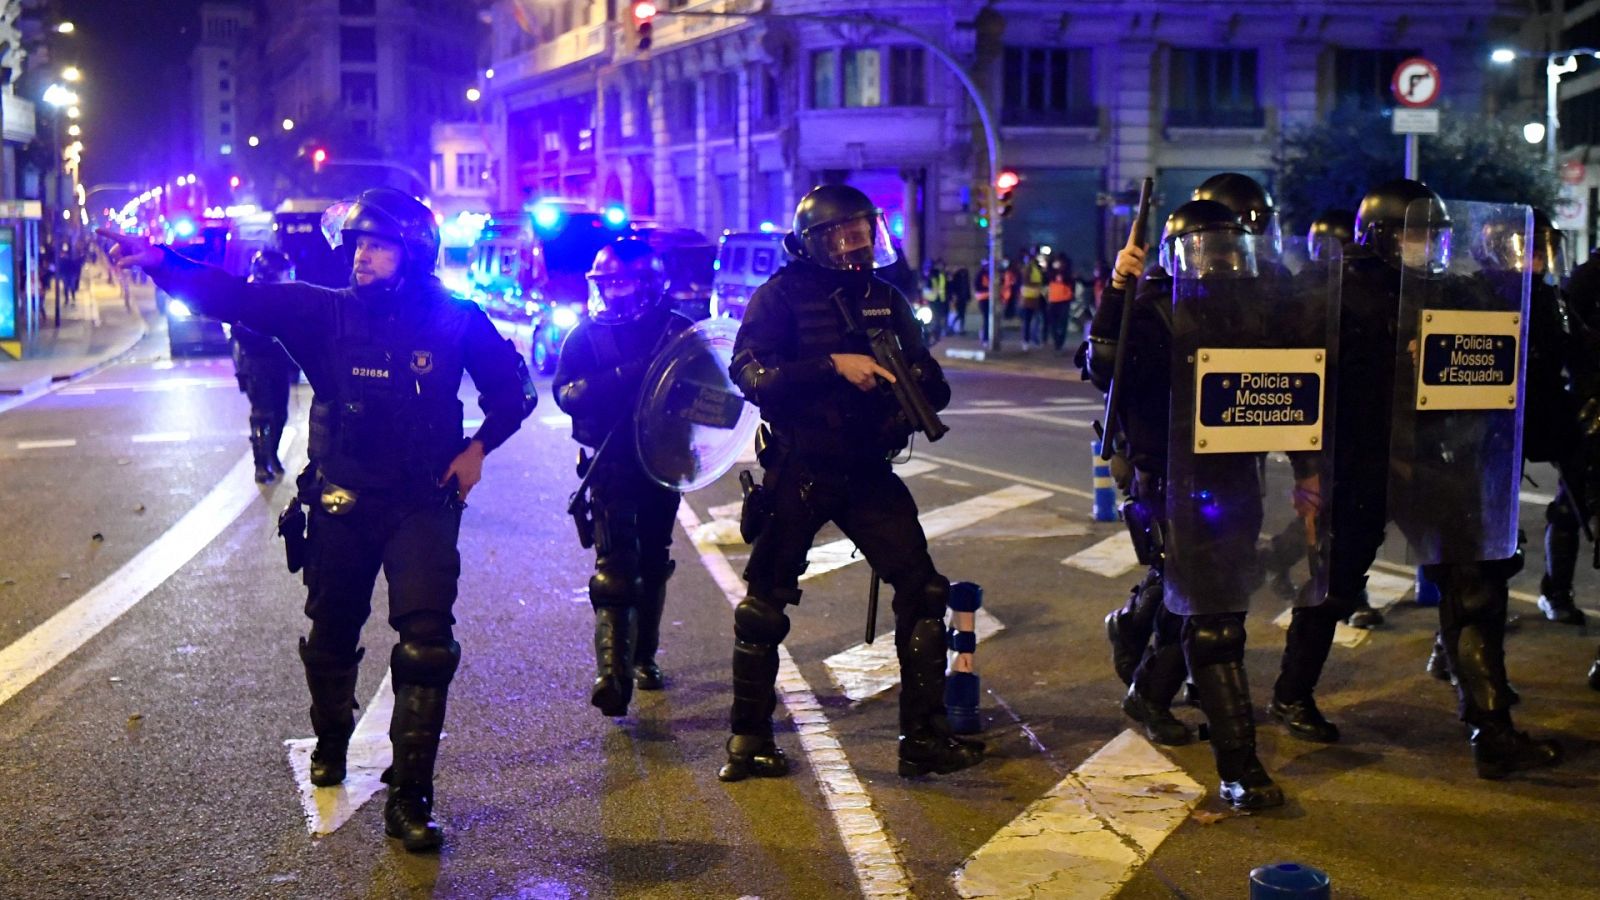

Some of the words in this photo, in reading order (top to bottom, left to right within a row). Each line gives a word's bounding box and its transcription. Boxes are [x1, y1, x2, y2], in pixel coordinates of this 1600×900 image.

[1454, 335, 1493, 350] Policia
[1450, 351, 1495, 366] Mossos
[352, 367, 389, 378] D21654
[1240, 373, 1290, 389] Policia
[1235, 390, 1293, 406] Mossos
[1222, 406, 1305, 426] d'Esquadra
